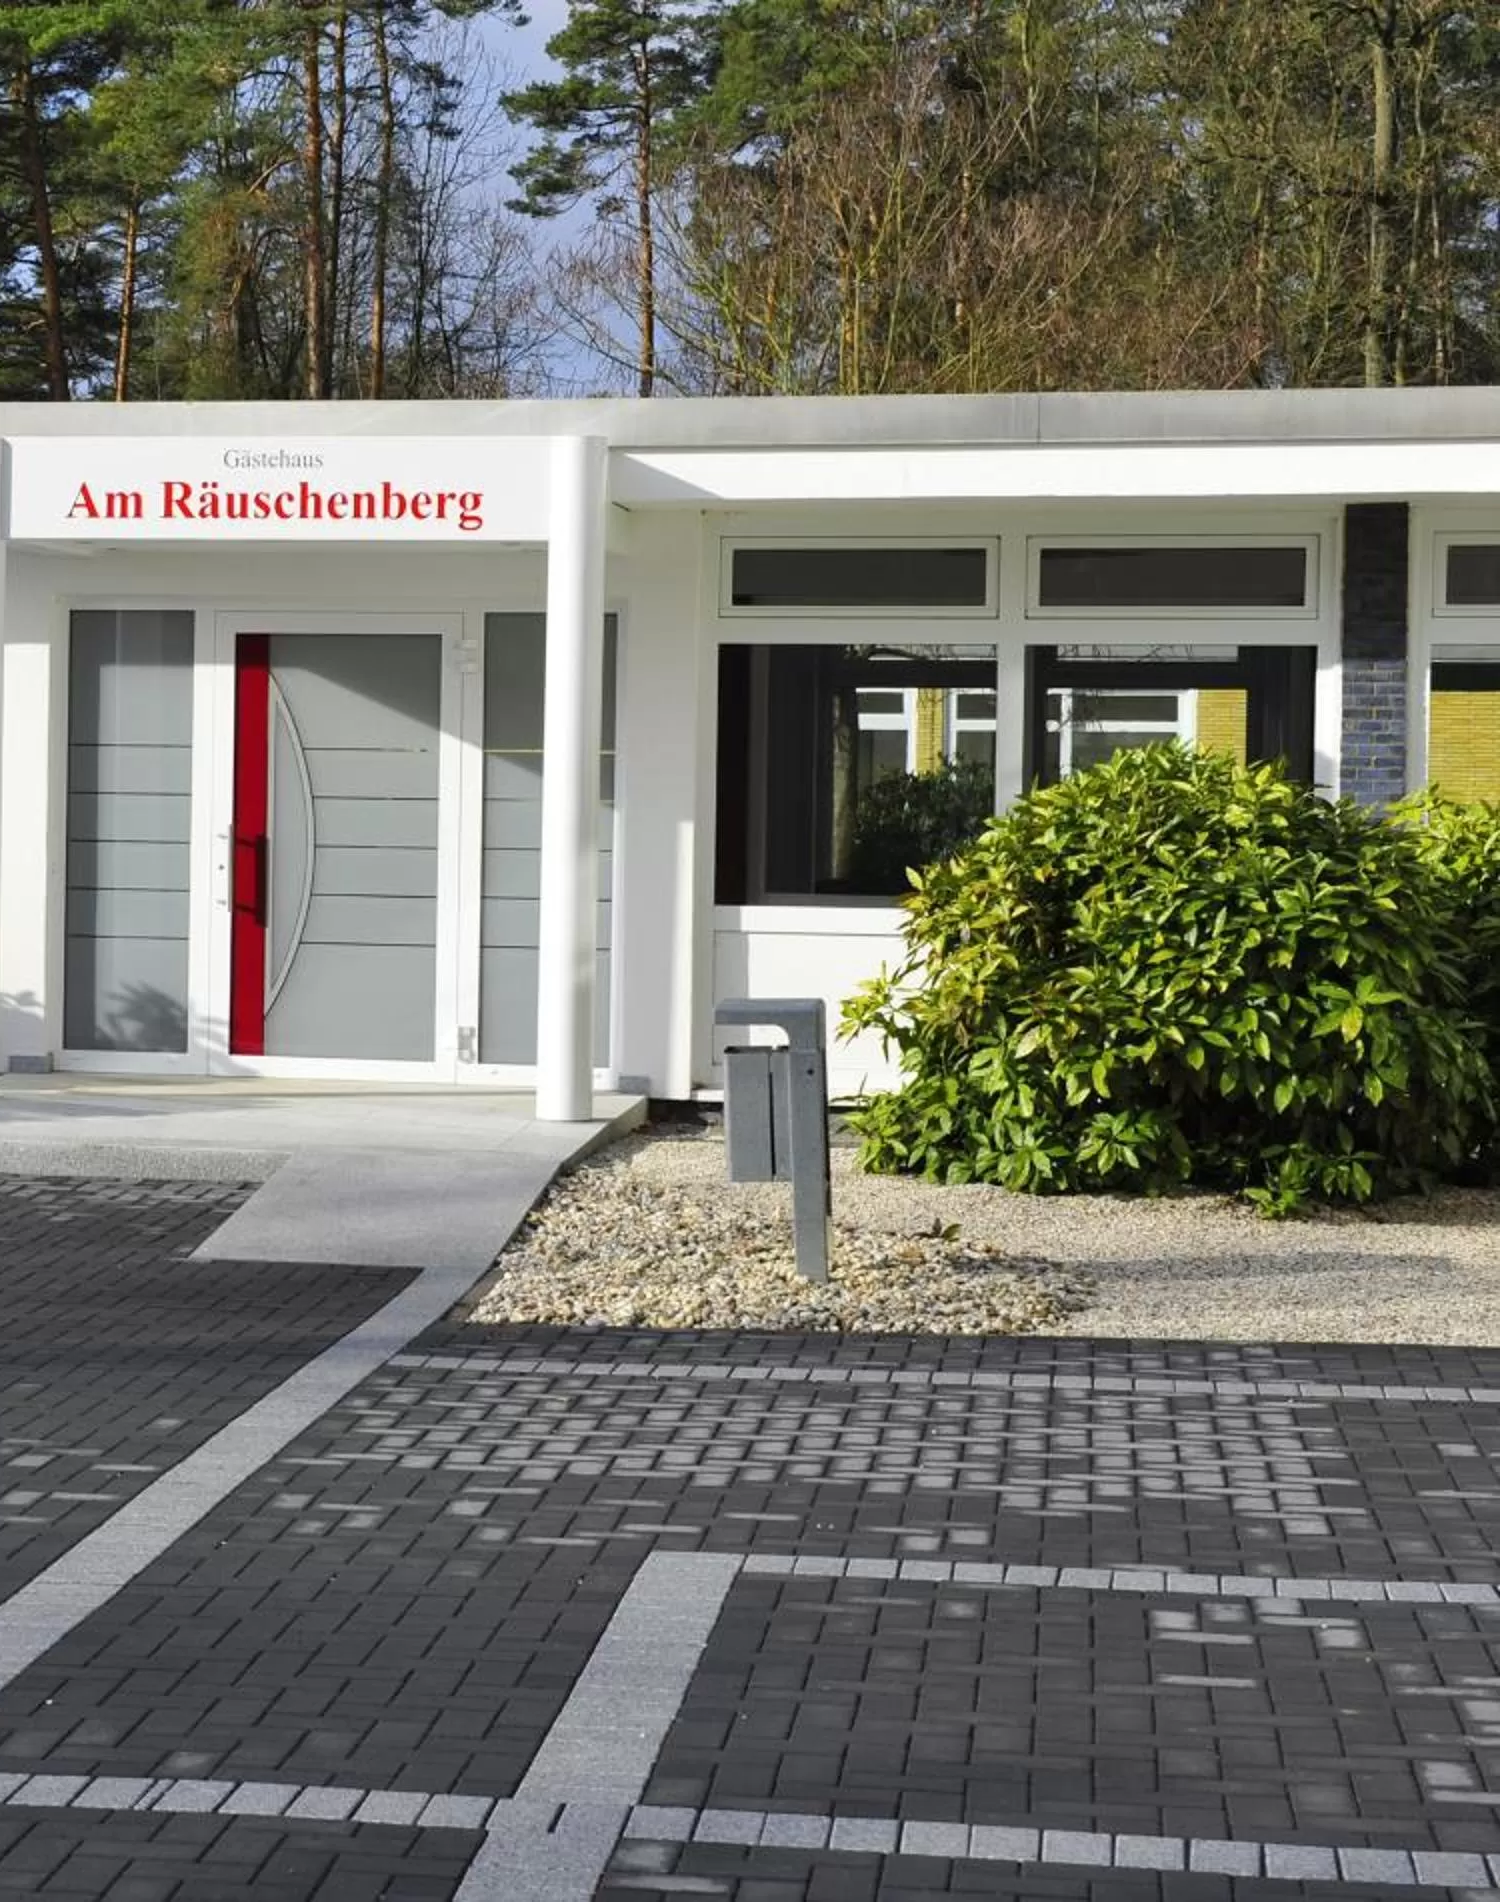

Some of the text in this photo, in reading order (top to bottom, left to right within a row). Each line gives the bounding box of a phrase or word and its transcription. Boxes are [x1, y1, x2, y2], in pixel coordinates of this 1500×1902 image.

[222, 448, 324, 469] Gästehaus
[67, 481, 483, 530] Am Räuschenberg
